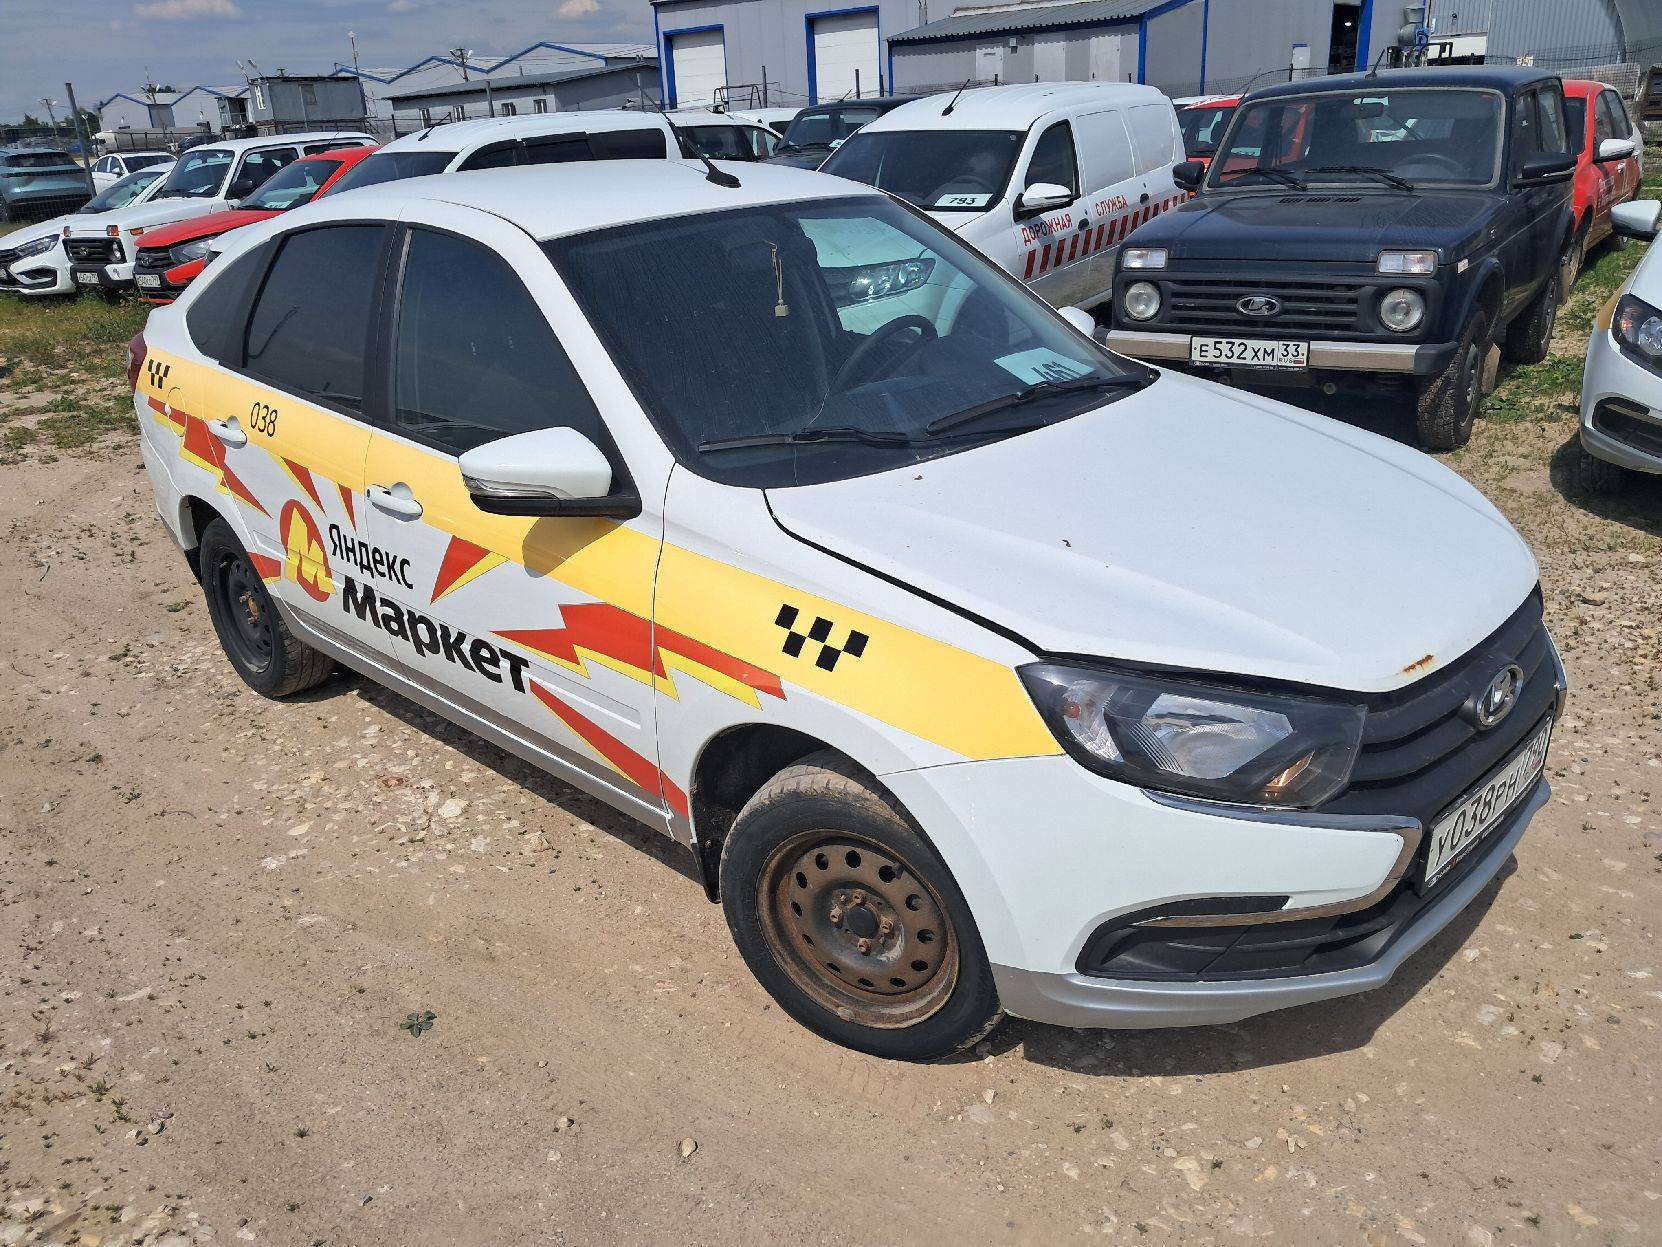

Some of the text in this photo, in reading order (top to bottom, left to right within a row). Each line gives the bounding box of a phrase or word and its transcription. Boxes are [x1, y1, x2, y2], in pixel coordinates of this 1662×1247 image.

[949, 196, 977, 205] 793
[1021, 194, 1129, 246] ДОРОЖНАЯ СЛУЖБА
[1280, 343, 1301, 358] 33
[250, 402, 278, 437] 038
[328, 523, 414, 590] Яндекс
[342, 575, 530, 694] Маркет
